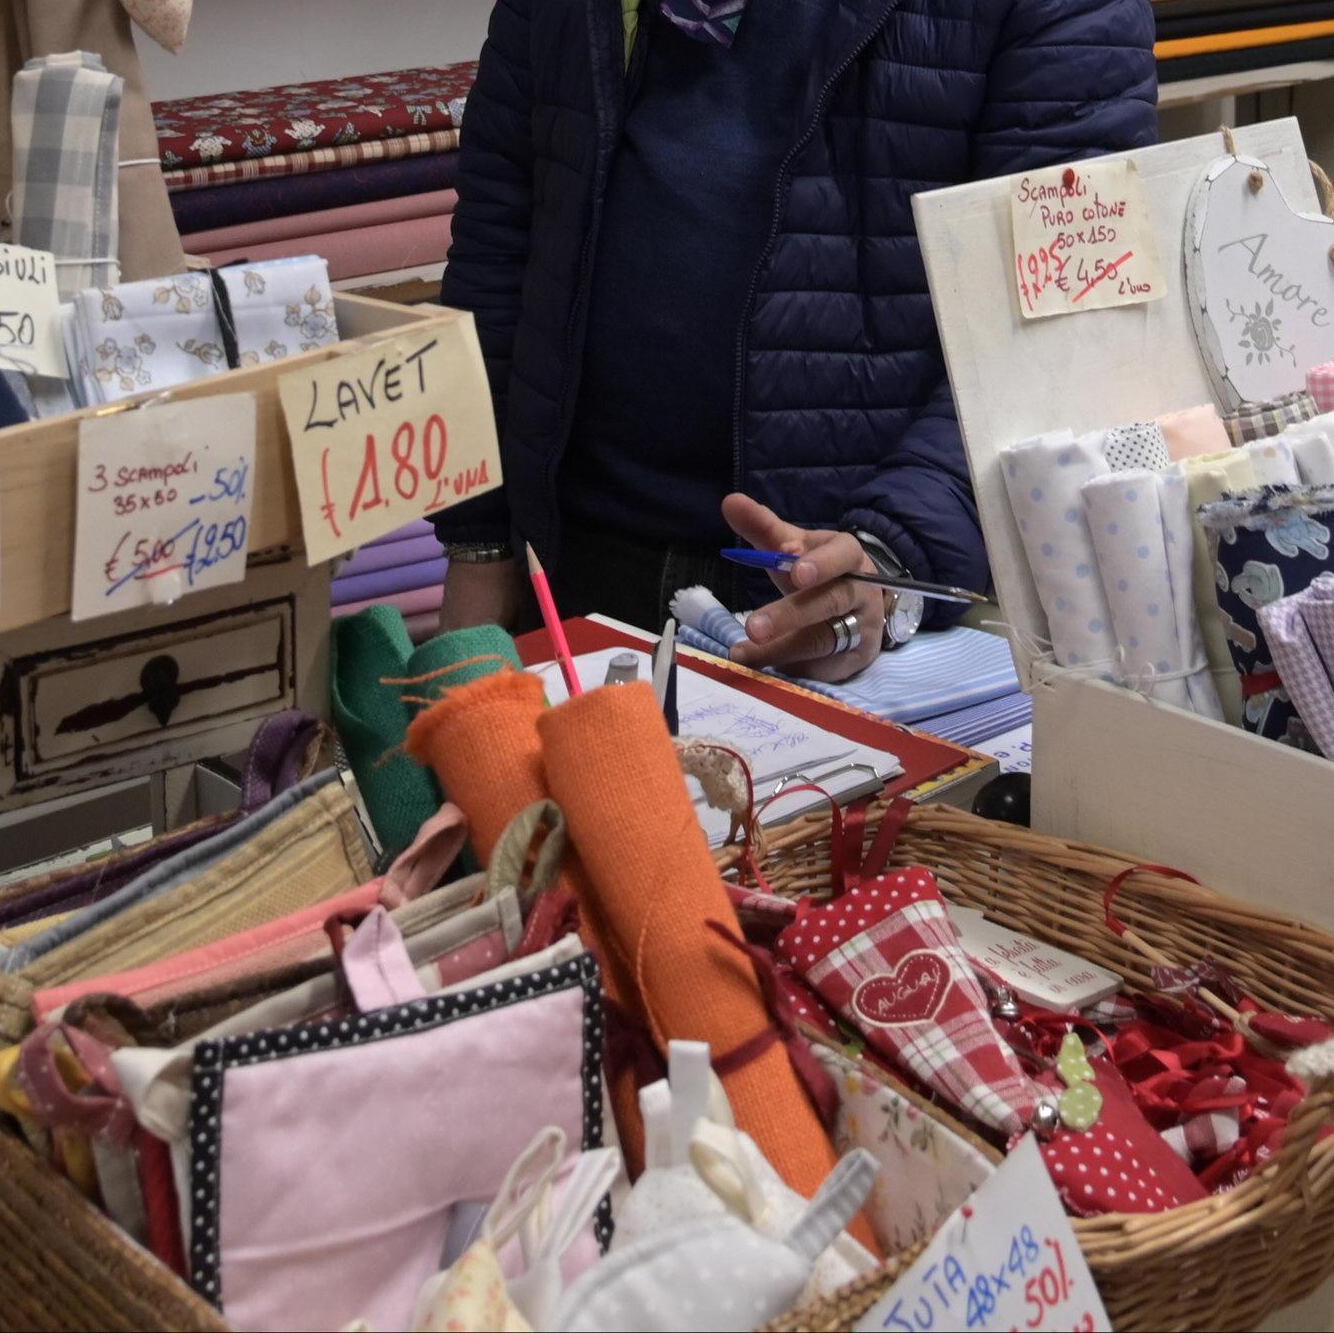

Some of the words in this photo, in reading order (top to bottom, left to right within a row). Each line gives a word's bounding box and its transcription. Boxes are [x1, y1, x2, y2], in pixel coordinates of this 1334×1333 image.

[1217, 233, 1331, 328] Amore
[303, 338, 439, 433] LAVET
[87, 464, 109, 492] 3
